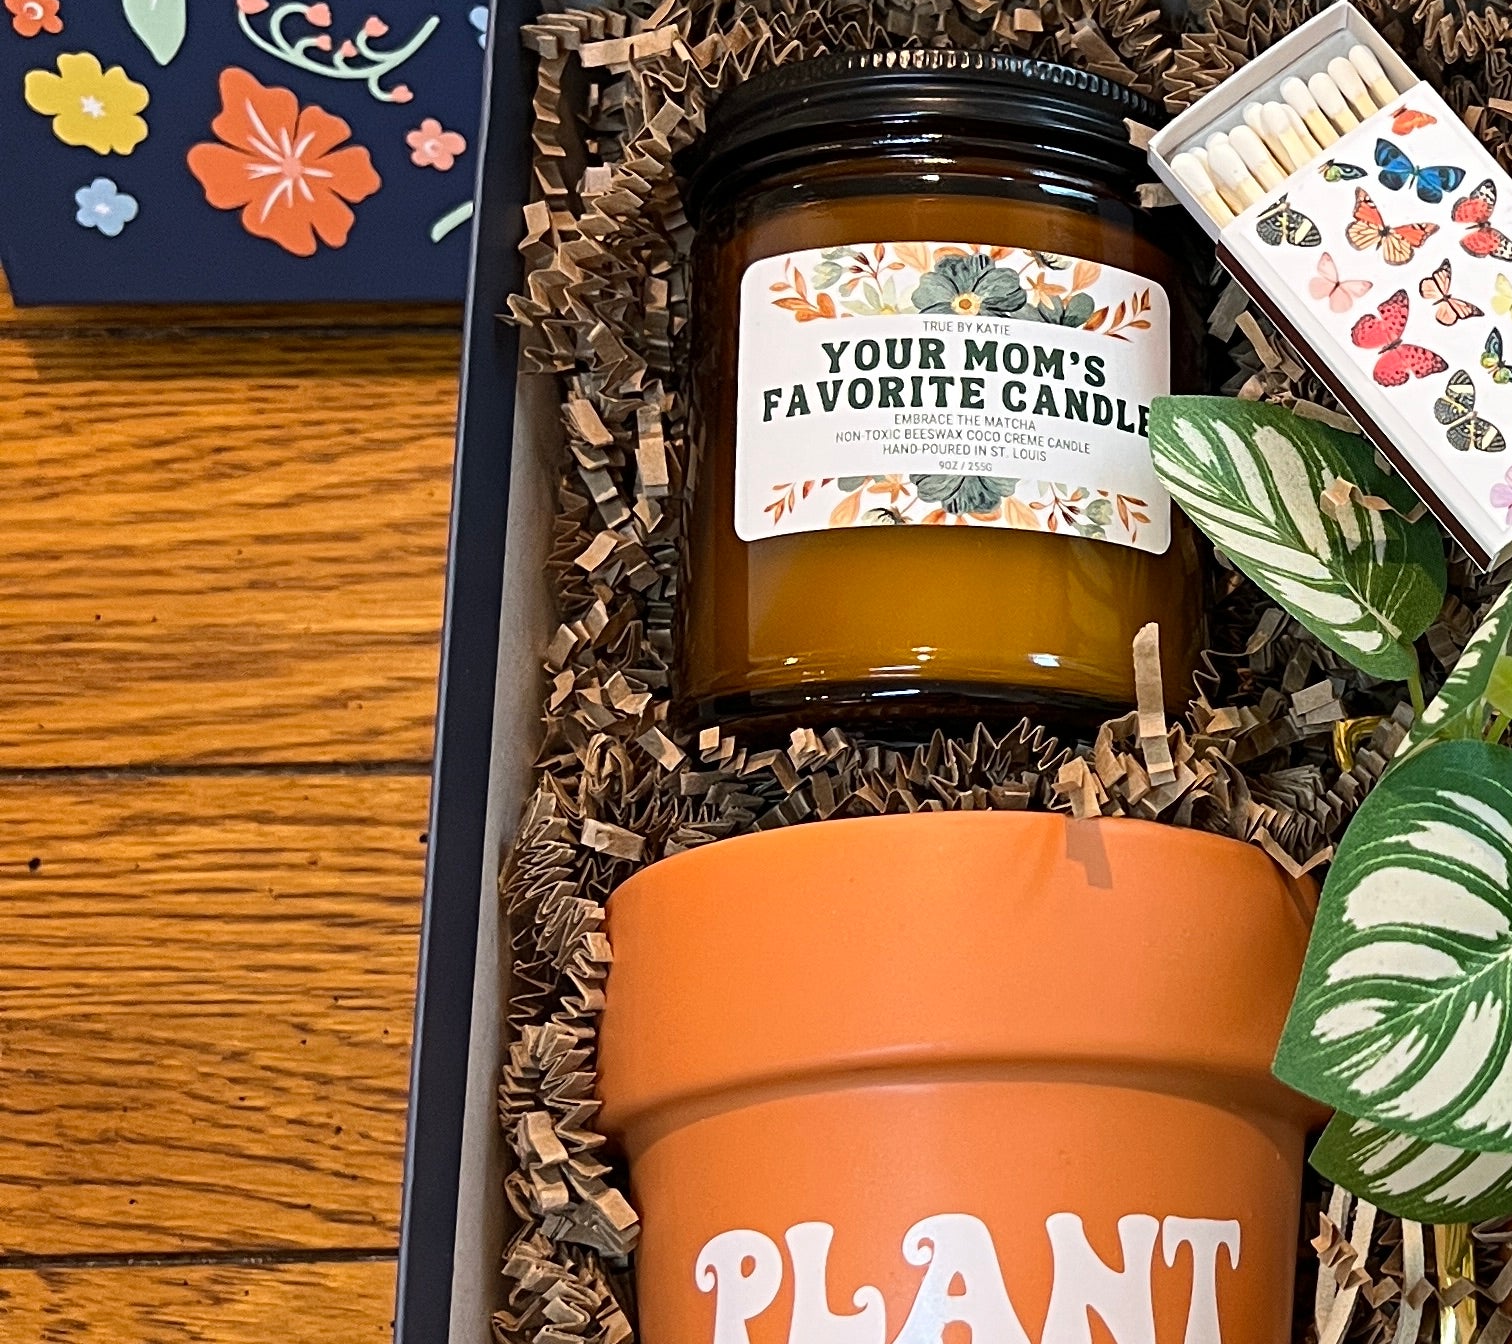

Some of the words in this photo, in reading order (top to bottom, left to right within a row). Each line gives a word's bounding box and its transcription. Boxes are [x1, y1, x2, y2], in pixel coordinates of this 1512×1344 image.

[923, 320, 954, 332] TRUE
[957, 322, 973, 334] BY
[976, 323, 1011, 336] KATIE
[821, 337, 946, 374] YOUR
[963, 339, 1106, 388] MOM'S
[762, 376, 985, 422] FAVORITE
[894, 413, 954, 425] EMBRACE
[957, 414, 981, 426] THE
[984, 415, 1036, 431] MATCHA
[835, 429, 901, 443] NON-TOXIC
[904, 428, 963, 441] BEESWAX
[966, 430, 1001, 443] COCO
[1004, 432, 1045, 447] CREME
[1047, 437, 1091, 455] CANDLE
[882, 443, 971, 456] HAND-POURED
[974, 445, 987, 456] IN
[990, 445, 1009, 458] ST.
[1013, 447, 1047, 462] LOUIS
[967, 460, 993, 472] 255G
